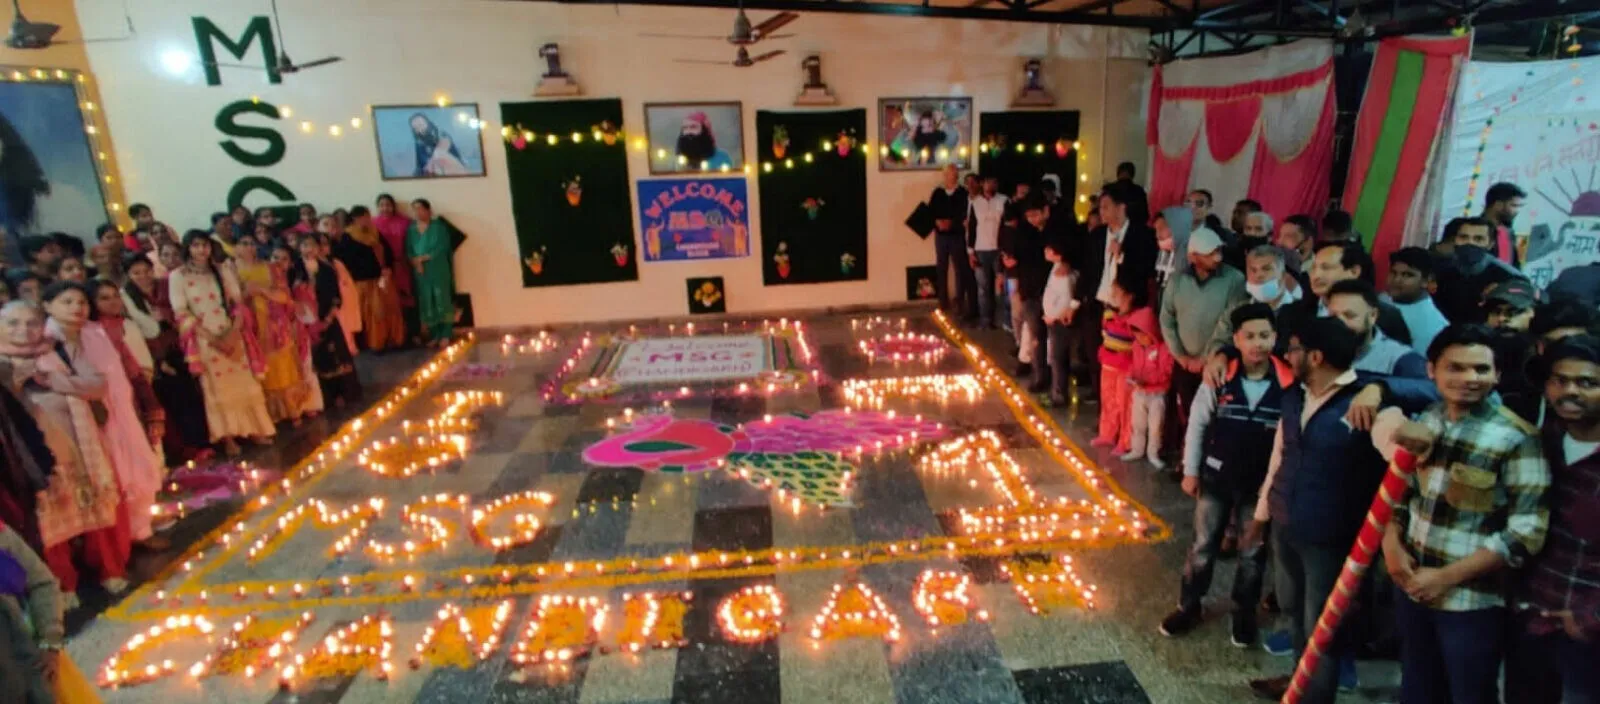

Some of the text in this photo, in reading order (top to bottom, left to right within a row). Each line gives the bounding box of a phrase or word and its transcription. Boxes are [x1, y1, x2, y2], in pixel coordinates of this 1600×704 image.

[644, 181, 744, 219] WELCOME
[647, 350, 733, 364] MSG
[245, 488, 558, 565] MSG
[97, 553, 1099, 688] CHANDIGARH
